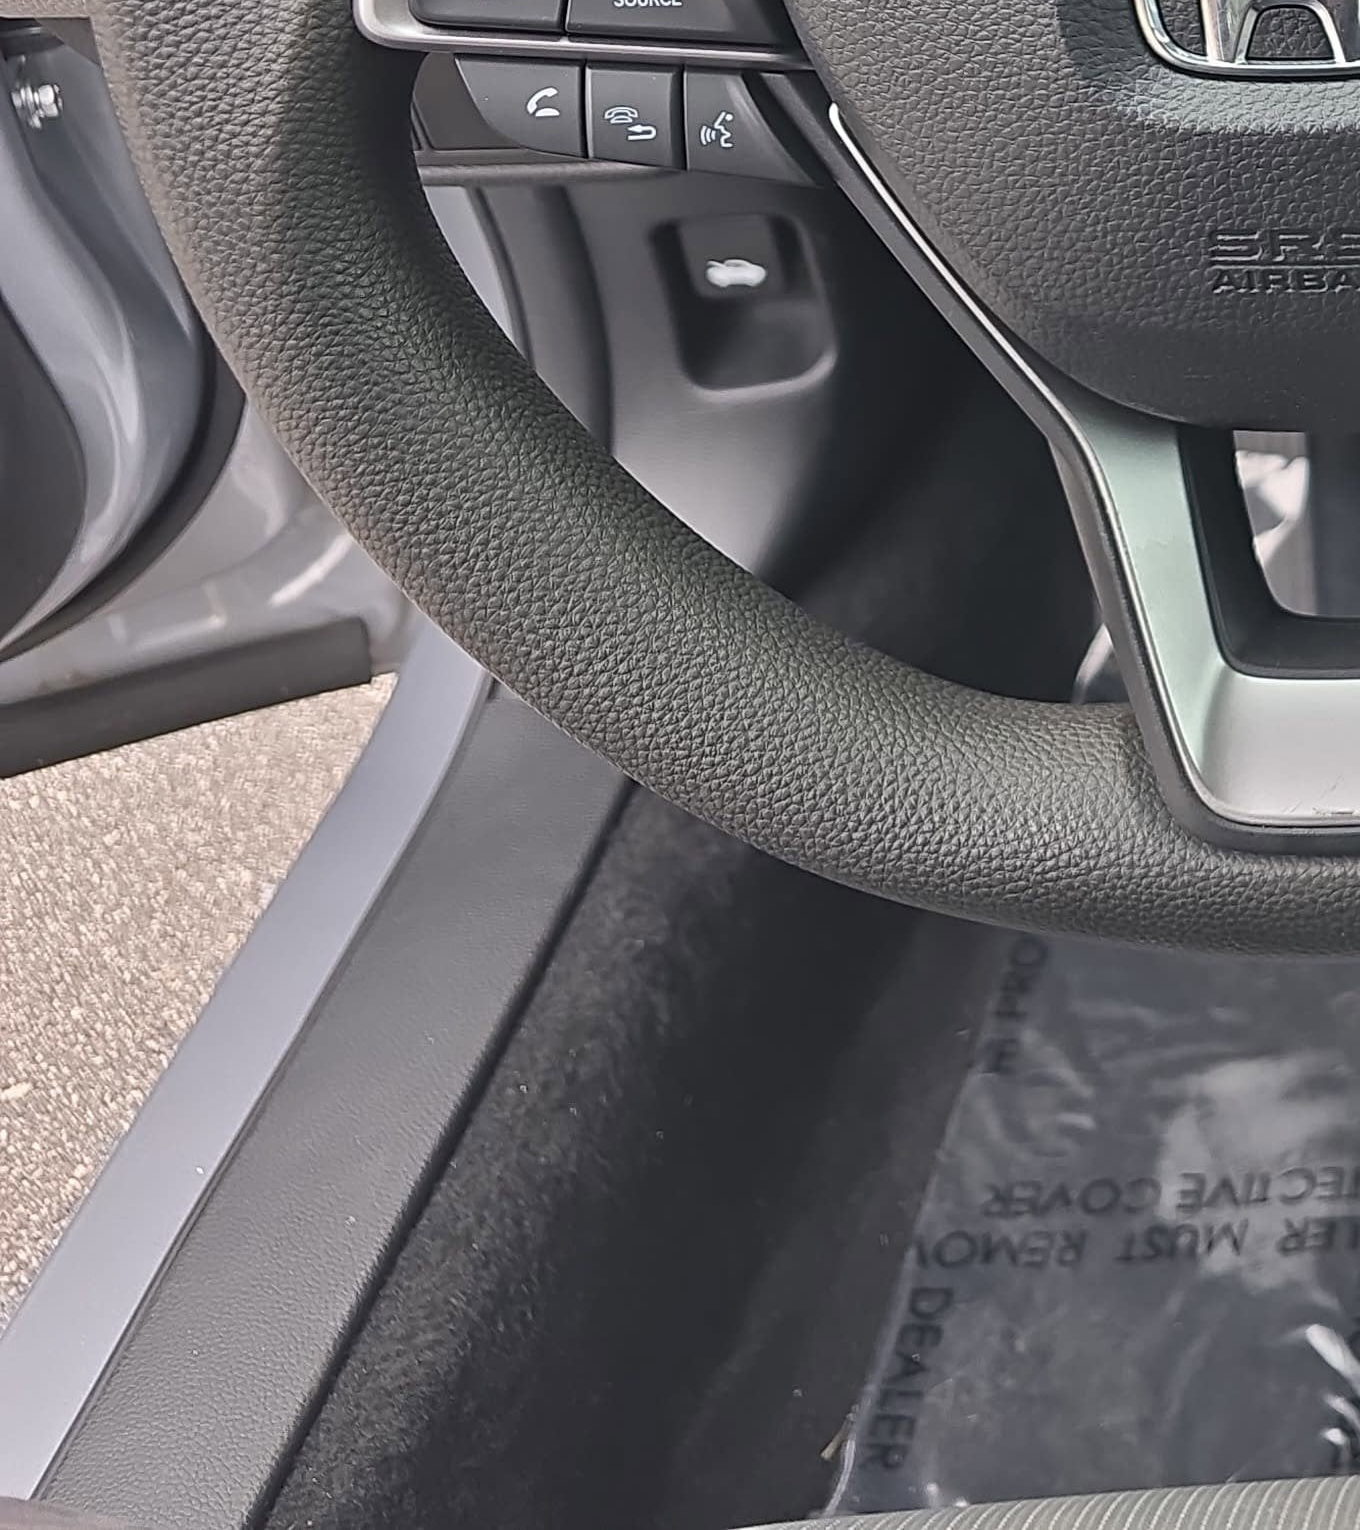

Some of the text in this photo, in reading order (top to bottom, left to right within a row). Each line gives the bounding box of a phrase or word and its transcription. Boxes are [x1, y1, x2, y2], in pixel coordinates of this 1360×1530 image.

[979, 1175, 1163, 1219] COVER
[1113, 1218, 1248, 1261] MUST
[858, 1285, 956, 1471] DEALER
